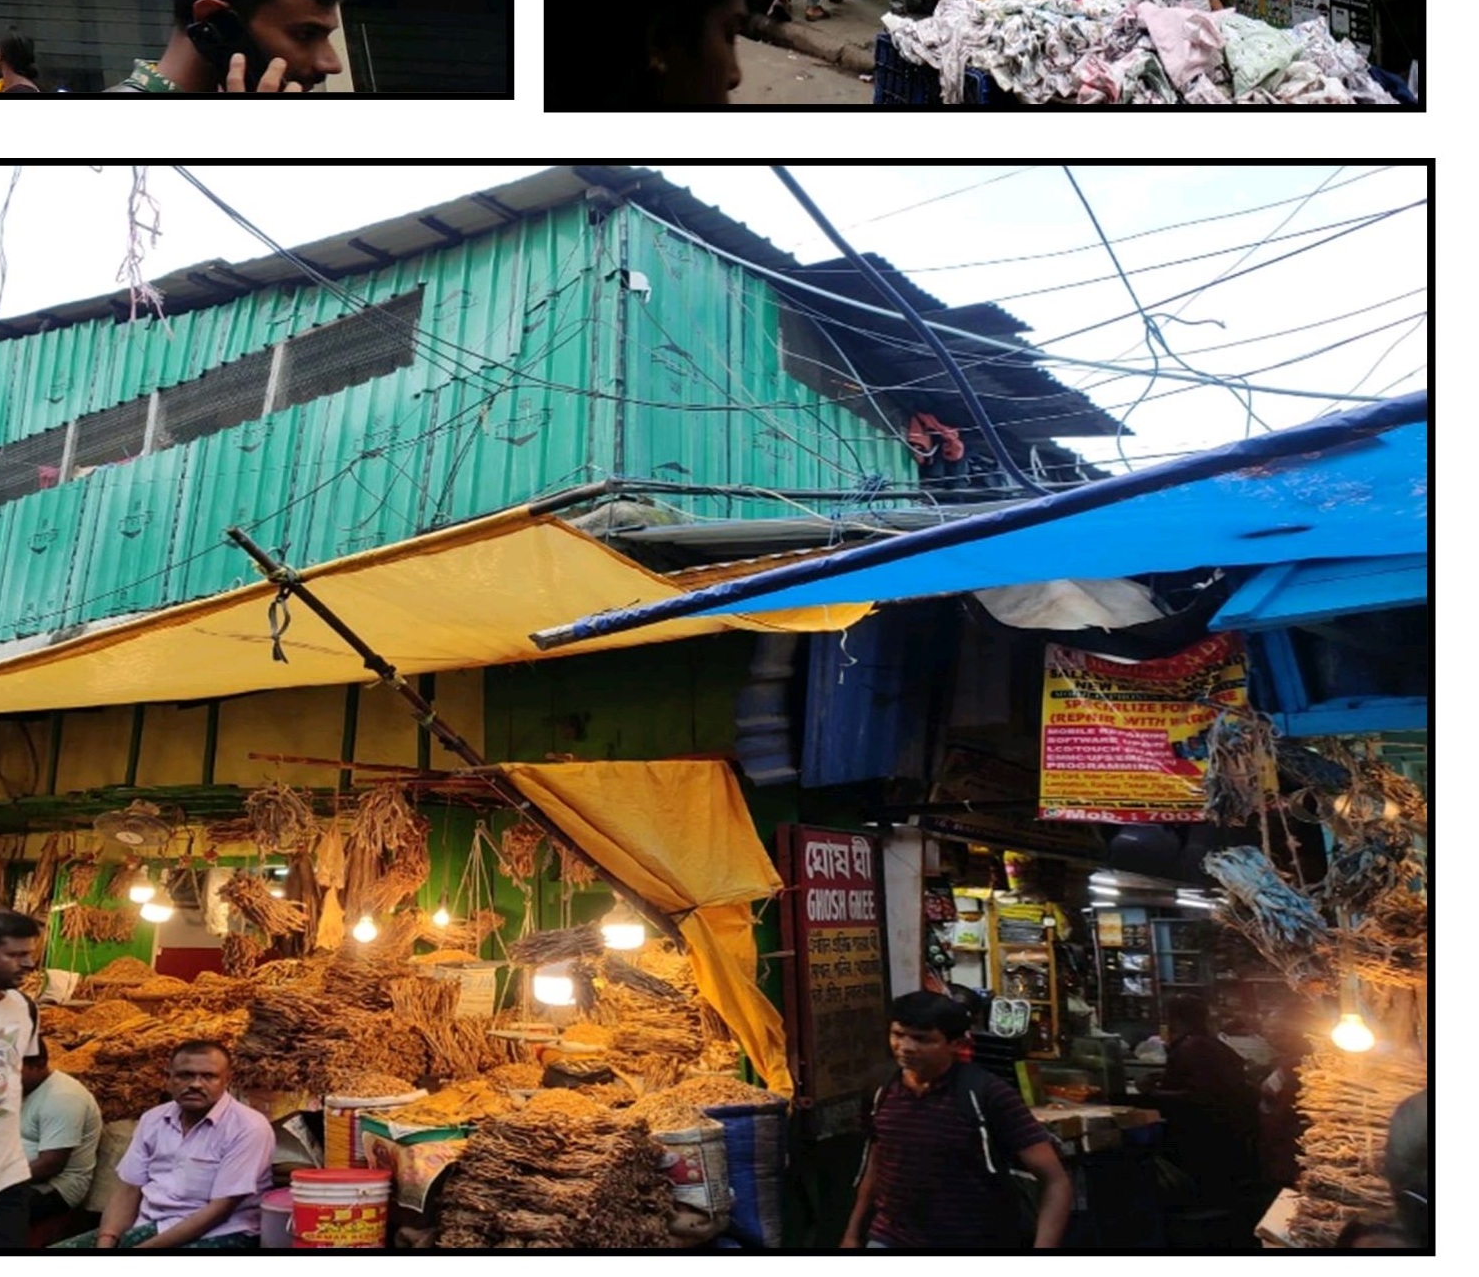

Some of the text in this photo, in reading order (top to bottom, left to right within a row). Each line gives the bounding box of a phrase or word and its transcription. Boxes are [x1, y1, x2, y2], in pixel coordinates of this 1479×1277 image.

[1064, 699, 1158, 714] SPECIALIZE
[1050, 712, 1116, 726] (REPAIR
[1124, 714, 1166, 727] WITH
[1098, 727, 1167, 740] REPAIRING
[1046, 763, 1161, 771] PROGRAMMING
[1064, 809, 1122, 820] Mob.
[805, 839, 850, 879] ঘোষ
[807, 888, 876, 921] GHOSH GHEE
